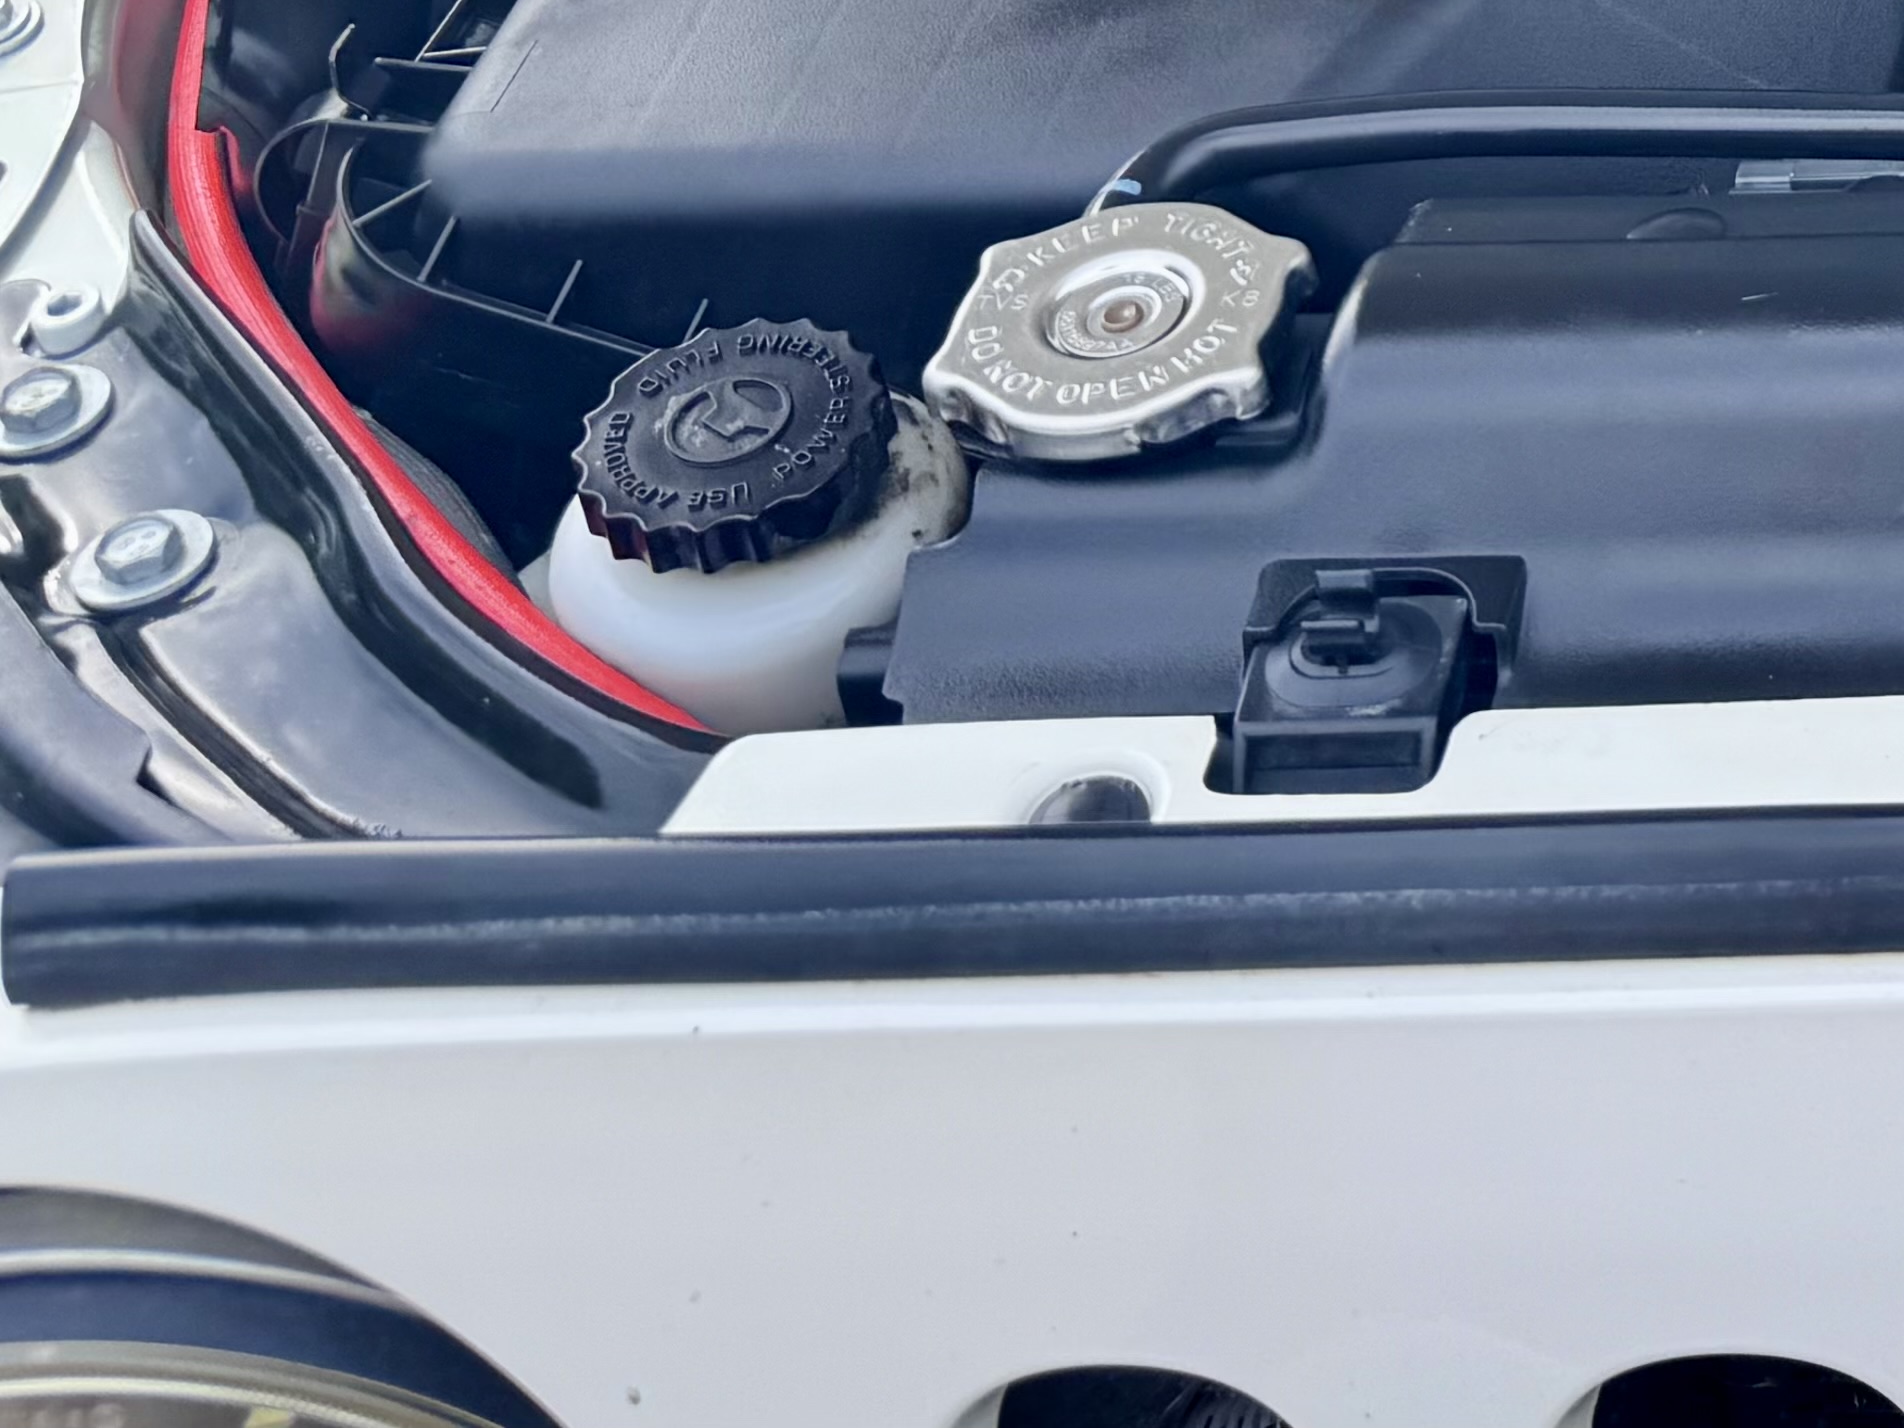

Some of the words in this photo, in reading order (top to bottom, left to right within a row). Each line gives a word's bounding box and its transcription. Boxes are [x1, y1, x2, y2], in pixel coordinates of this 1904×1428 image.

[637, 340, 723, 397] FLUID
[736, 333, 853, 394] STEERING
[967, 324, 1000, 361] DO
[1056, 363, 1171, 405] OPEN
[601, 410, 679, 511] APPROVED
[687, 480, 753, 513] USE
